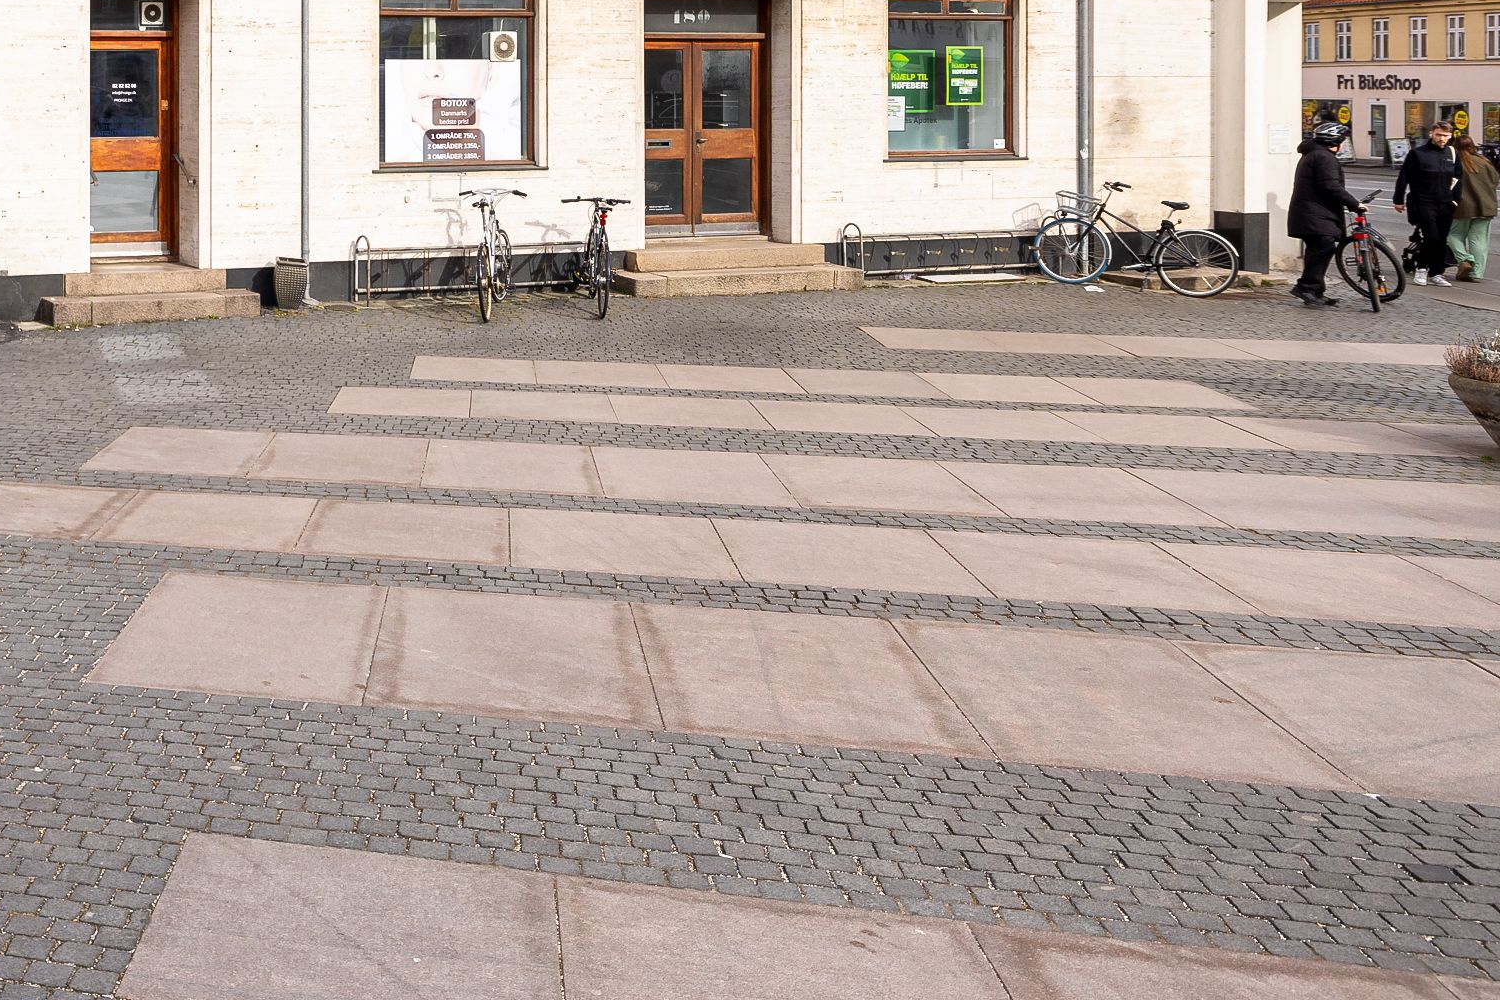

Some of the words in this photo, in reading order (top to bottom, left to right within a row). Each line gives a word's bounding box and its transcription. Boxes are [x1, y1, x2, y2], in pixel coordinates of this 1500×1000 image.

[673, 9, 710, 24] 180
[916, 73, 929, 81] TIL
[1337, 74, 1354, 90] Fri
[1358, 74, 1422, 95] BikeShop
[440, 99, 468, 107] BOTOX
[436, 131, 463, 140] OMRÅDE
[432, 142, 463, 150] OMRÅDER
[432, 152, 463, 160] OMRÅDER
